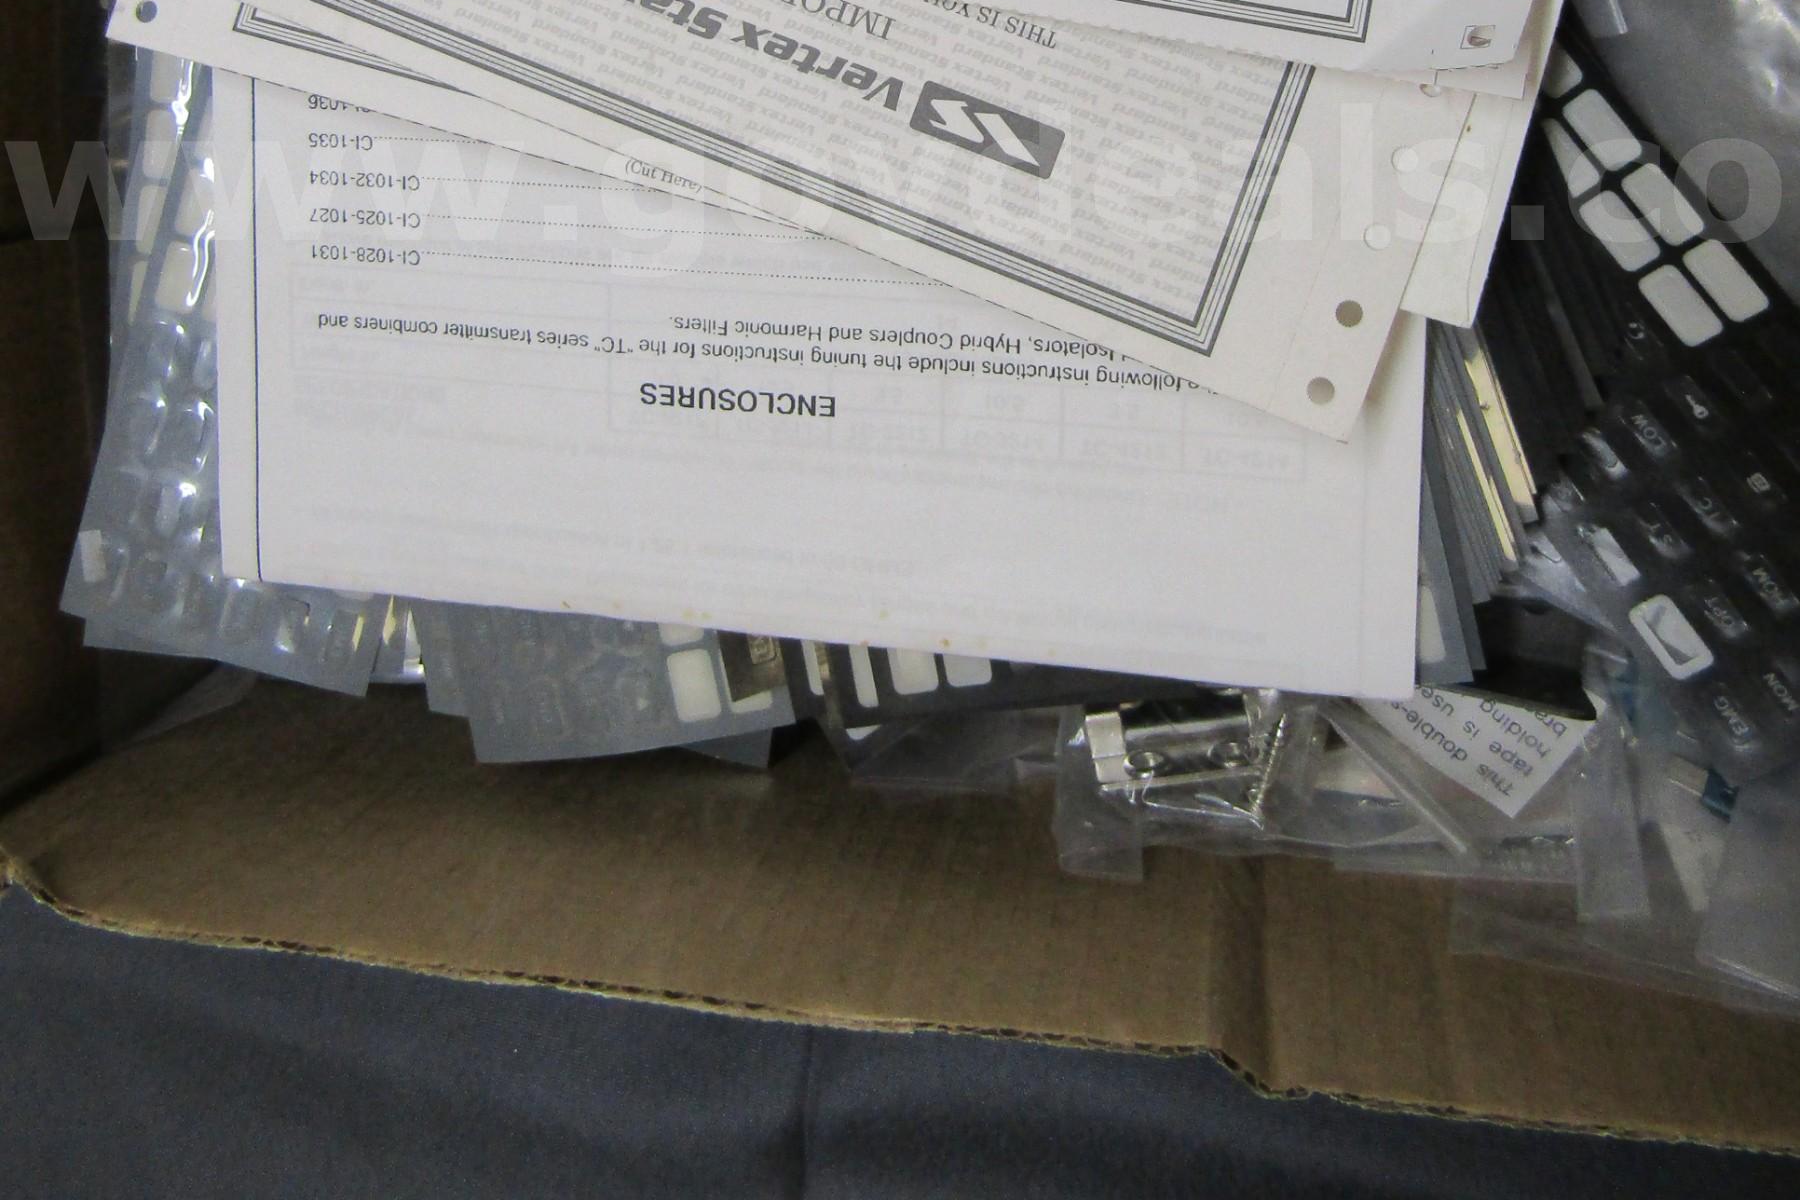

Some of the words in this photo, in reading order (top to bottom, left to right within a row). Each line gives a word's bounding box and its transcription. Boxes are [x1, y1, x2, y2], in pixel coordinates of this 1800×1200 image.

[976, 5, 1001, 26] IS
[1004, 15, 1056, 49] THIS
[729, 20, 903, 111] Vertex
[306, 93, 371, 112] 1036
[307, 132, 373, 151] CI-1035
[624, 156, 661, 179] (Cut
[309, 169, 420, 191] CI-1032-1034
[308, 207, 421, 229] CI-1025-1027
[311, 244, 421, 266] CI-1028-1031
[317, 313, 349, 329] and
[353, 315, 438, 334] combiners
[669, 316, 728, 336] Filters.
[734, 320, 822, 342] Harmonic
[442, 322, 532, 345] transmitter
[535, 330, 589, 349] series
[593, 335, 633, 354] "TC"
[828, 325, 863, 343] and
[868, 326, 953, 350] Couplers
[959, 332, 1021, 354] Hybrid
[638, 338, 666, 356] the
[671, 341, 695, 359] for
[700, 342, 804, 366] instructions
[810, 344, 867, 368] tuning
[872, 353, 902, 371] the
[907, 355, 975, 376] include
[981, 359, 1089, 386] instructions
[1095, 364, 1183, 392] following
[639, 381, 836, 418] ENCLOSURES
[1414, 684, 1454, 717] use
[1461, 719, 1480, 740] is
[1478, 697, 1550, 758] holding
[1487, 740, 1533, 777] tape
[1475, 762, 1513, 797] This
